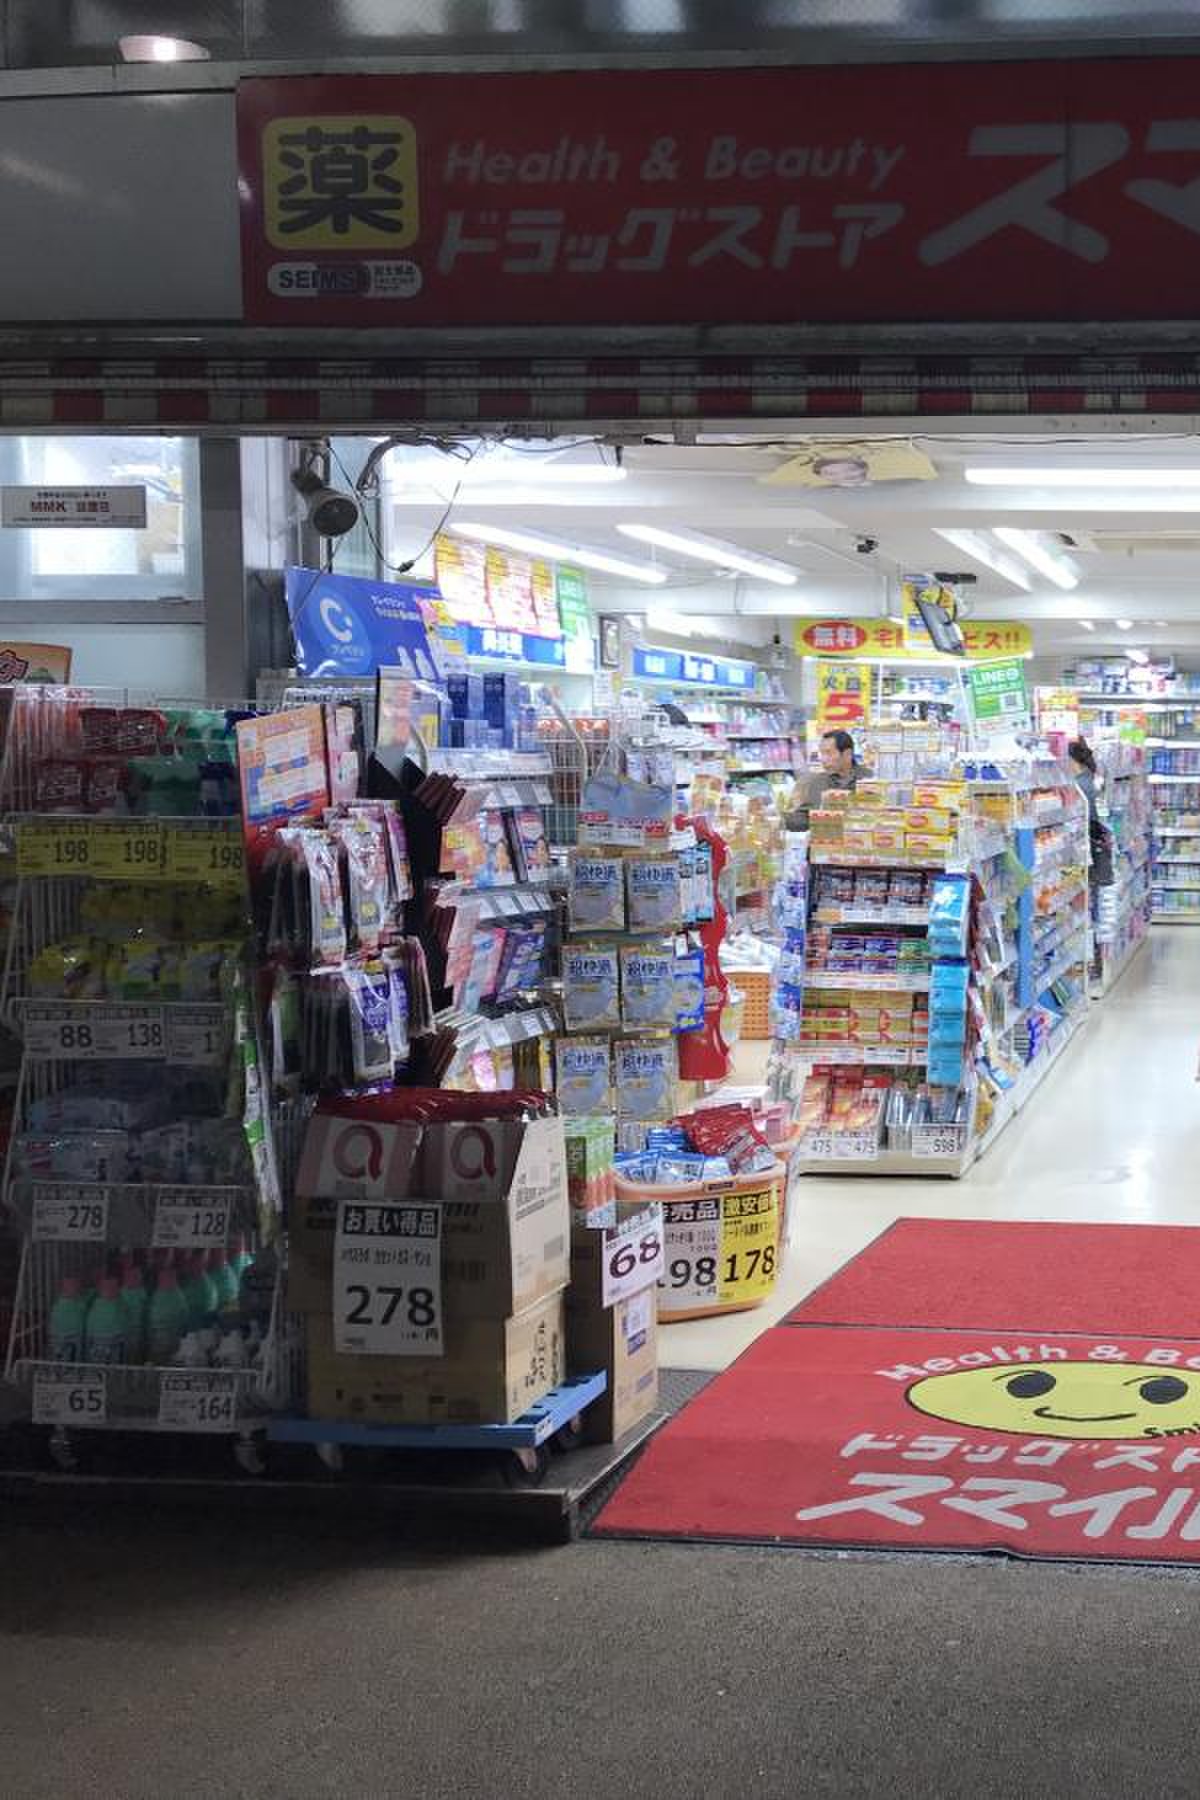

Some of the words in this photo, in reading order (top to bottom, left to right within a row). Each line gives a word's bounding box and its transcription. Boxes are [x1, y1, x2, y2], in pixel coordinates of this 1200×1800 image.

[442, 136, 622, 186] Health
[638, 137, 681, 182] &
[704, 137, 908, 184] Beauty
[278, 124, 404, 235] 薬
[438, 203, 906, 276] ドラッグストア
[53, 840, 88, 863] 198
[124, 840, 158, 863] 198
[60, 1026, 92, 1047] 88
[129, 1024, 161, 1046] 138
[68, 1206, 101, 1228] 278
[191, 1214, 225, 1235] 128
[609, 1233, 660, 1280] 68
[724, 1246, 775, 1282] 178
[657, 1257, 716, 1288] 98
[347, 1286, 435, 1327] 278
[873, 1345, 1069, 1381] Health
[68, 1391, 101, 1411] 65
